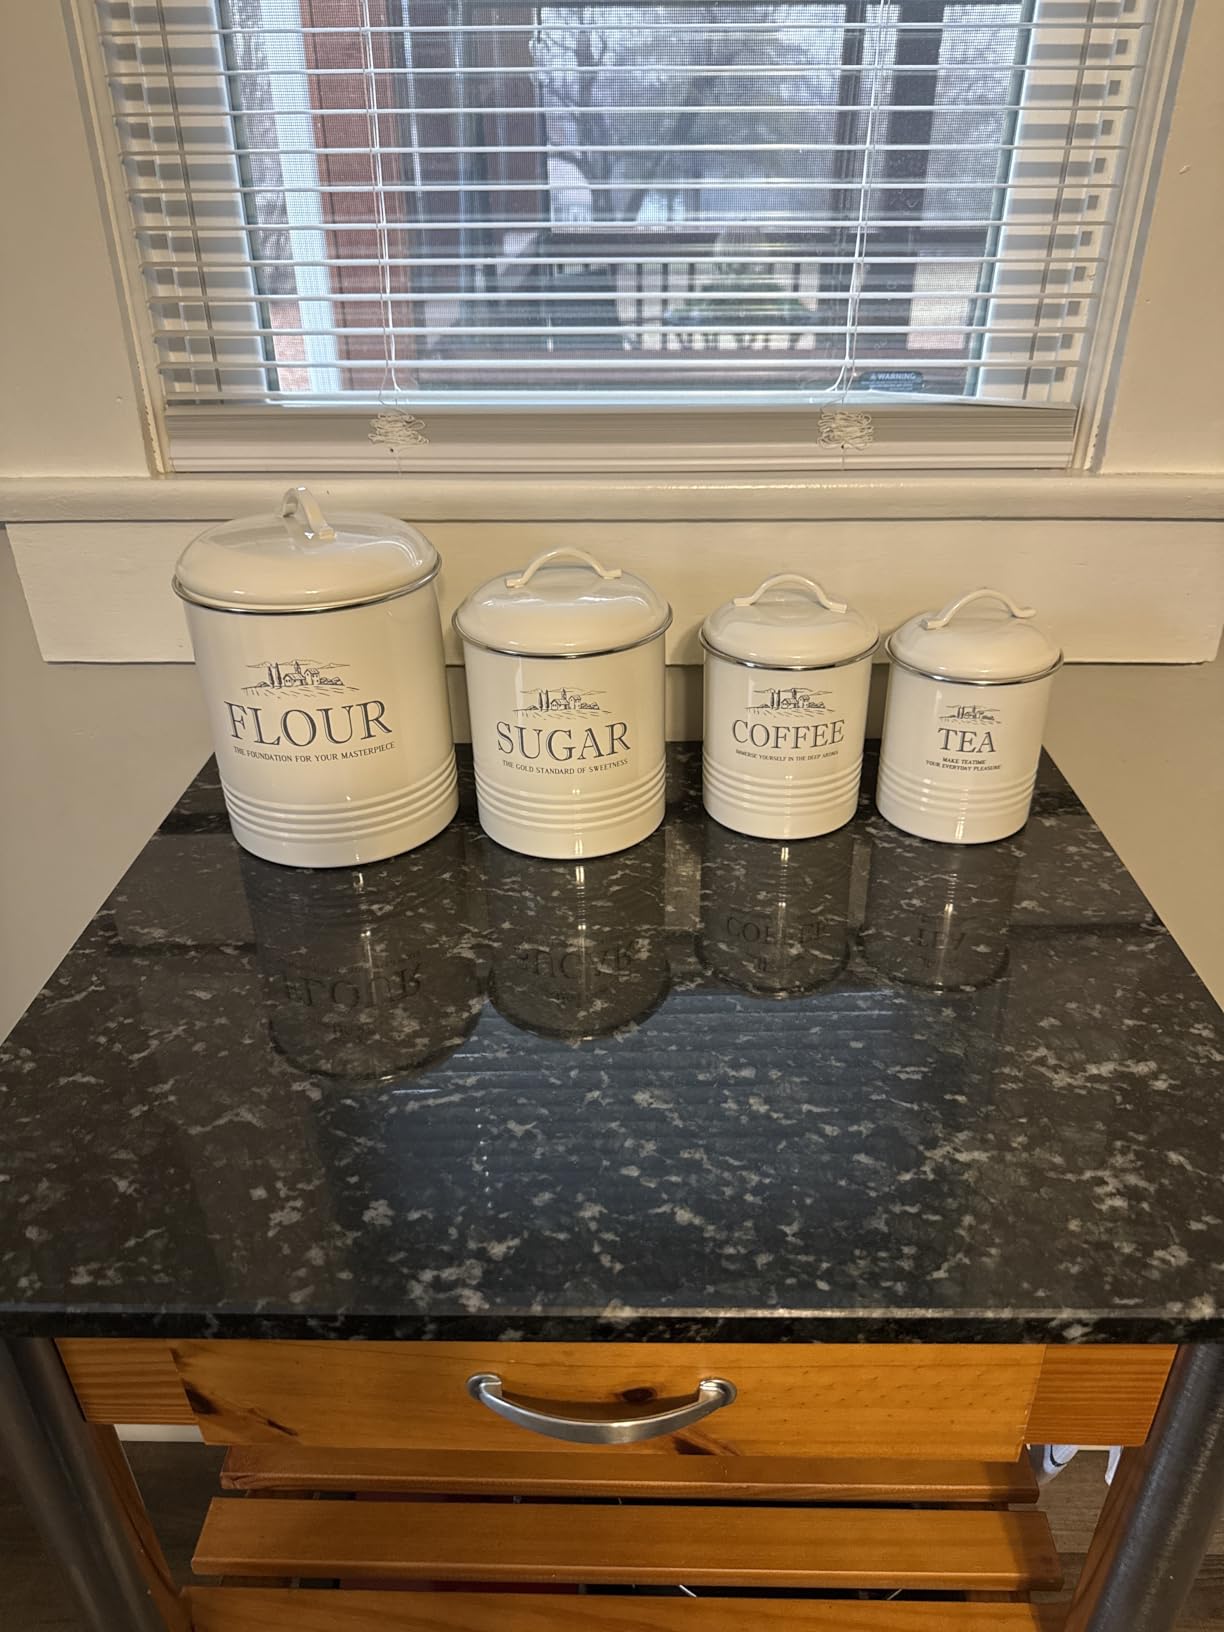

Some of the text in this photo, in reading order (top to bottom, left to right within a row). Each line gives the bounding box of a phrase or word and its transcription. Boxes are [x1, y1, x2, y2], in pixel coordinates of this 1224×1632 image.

[877, 372, 916, 380] WARNING
[224, 700, 392, 747] FLOUR
[732, 719, 845, 749] COFFEE
[233, 741, 396, 763] THE FOUNDATION FOR YOUR MASTERPIECE
[496, 721, 631, 761] SUGAR
[937, 727, 996, 753] TEA
[503, 760, 514, 768] THE
[515, 764, 534, 773] GOLD
[536, 767, 575, 775] STANDARD
[589, 760, 628, 772] SWEETNESS
[926, 759, 941, 767] YOUR
[942, 763, 972, 771] EVERYDAY
